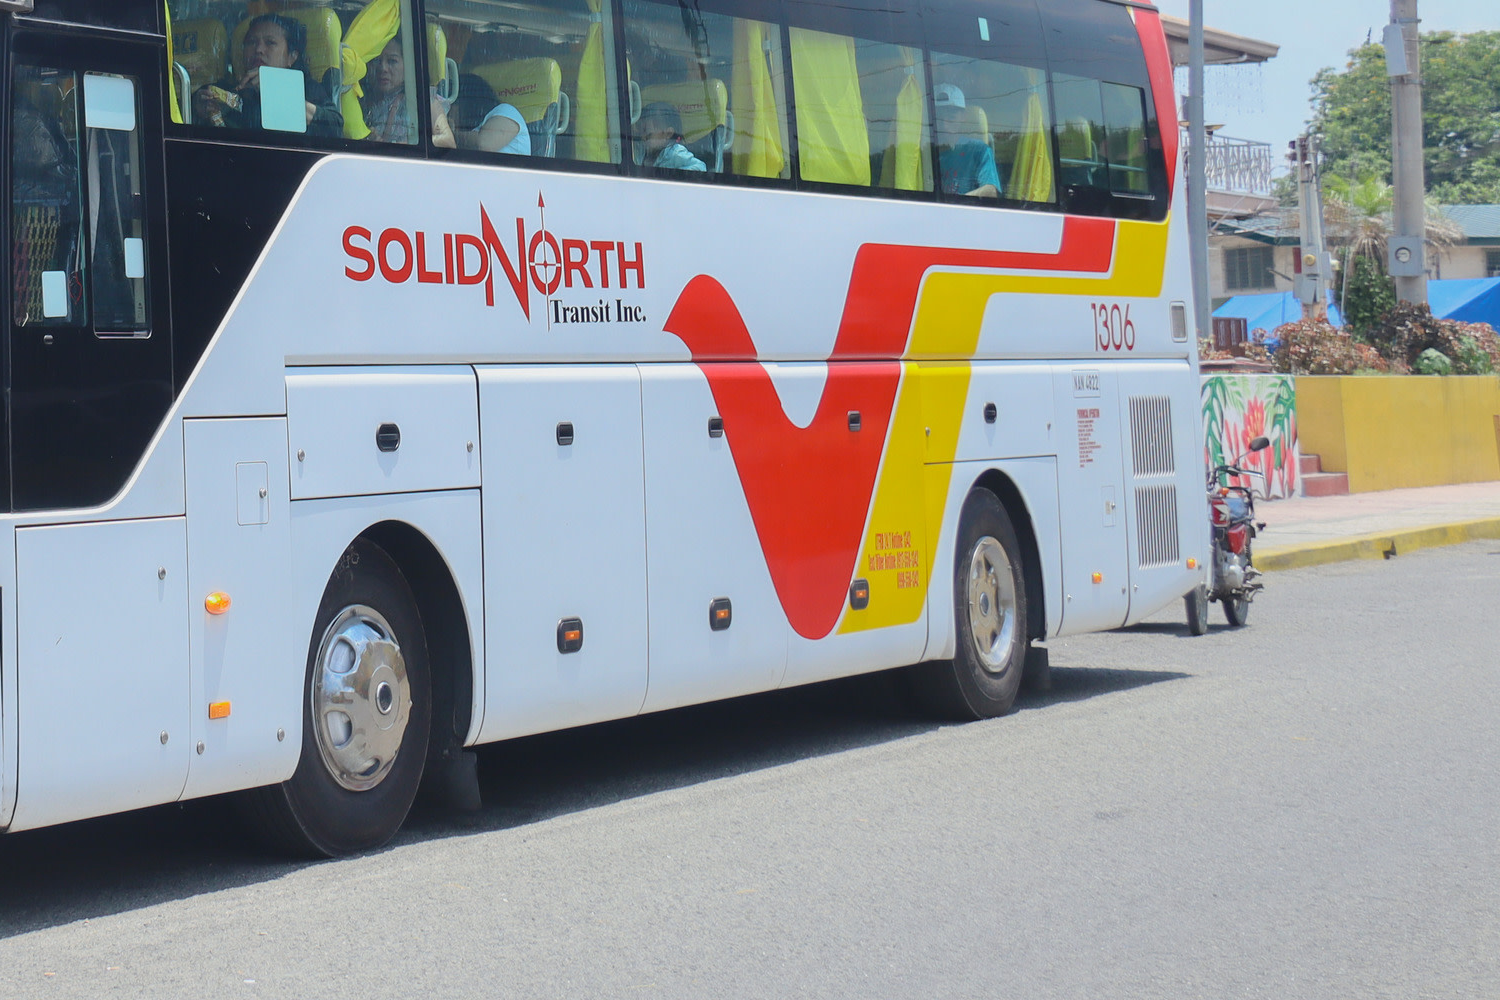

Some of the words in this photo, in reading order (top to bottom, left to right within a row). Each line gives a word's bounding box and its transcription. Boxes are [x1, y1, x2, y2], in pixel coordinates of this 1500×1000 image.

[550, 299, 611, 323] Transit
[616, 299, 647, 323] Inc.
[1091, 303, 1135, 352] 1306
